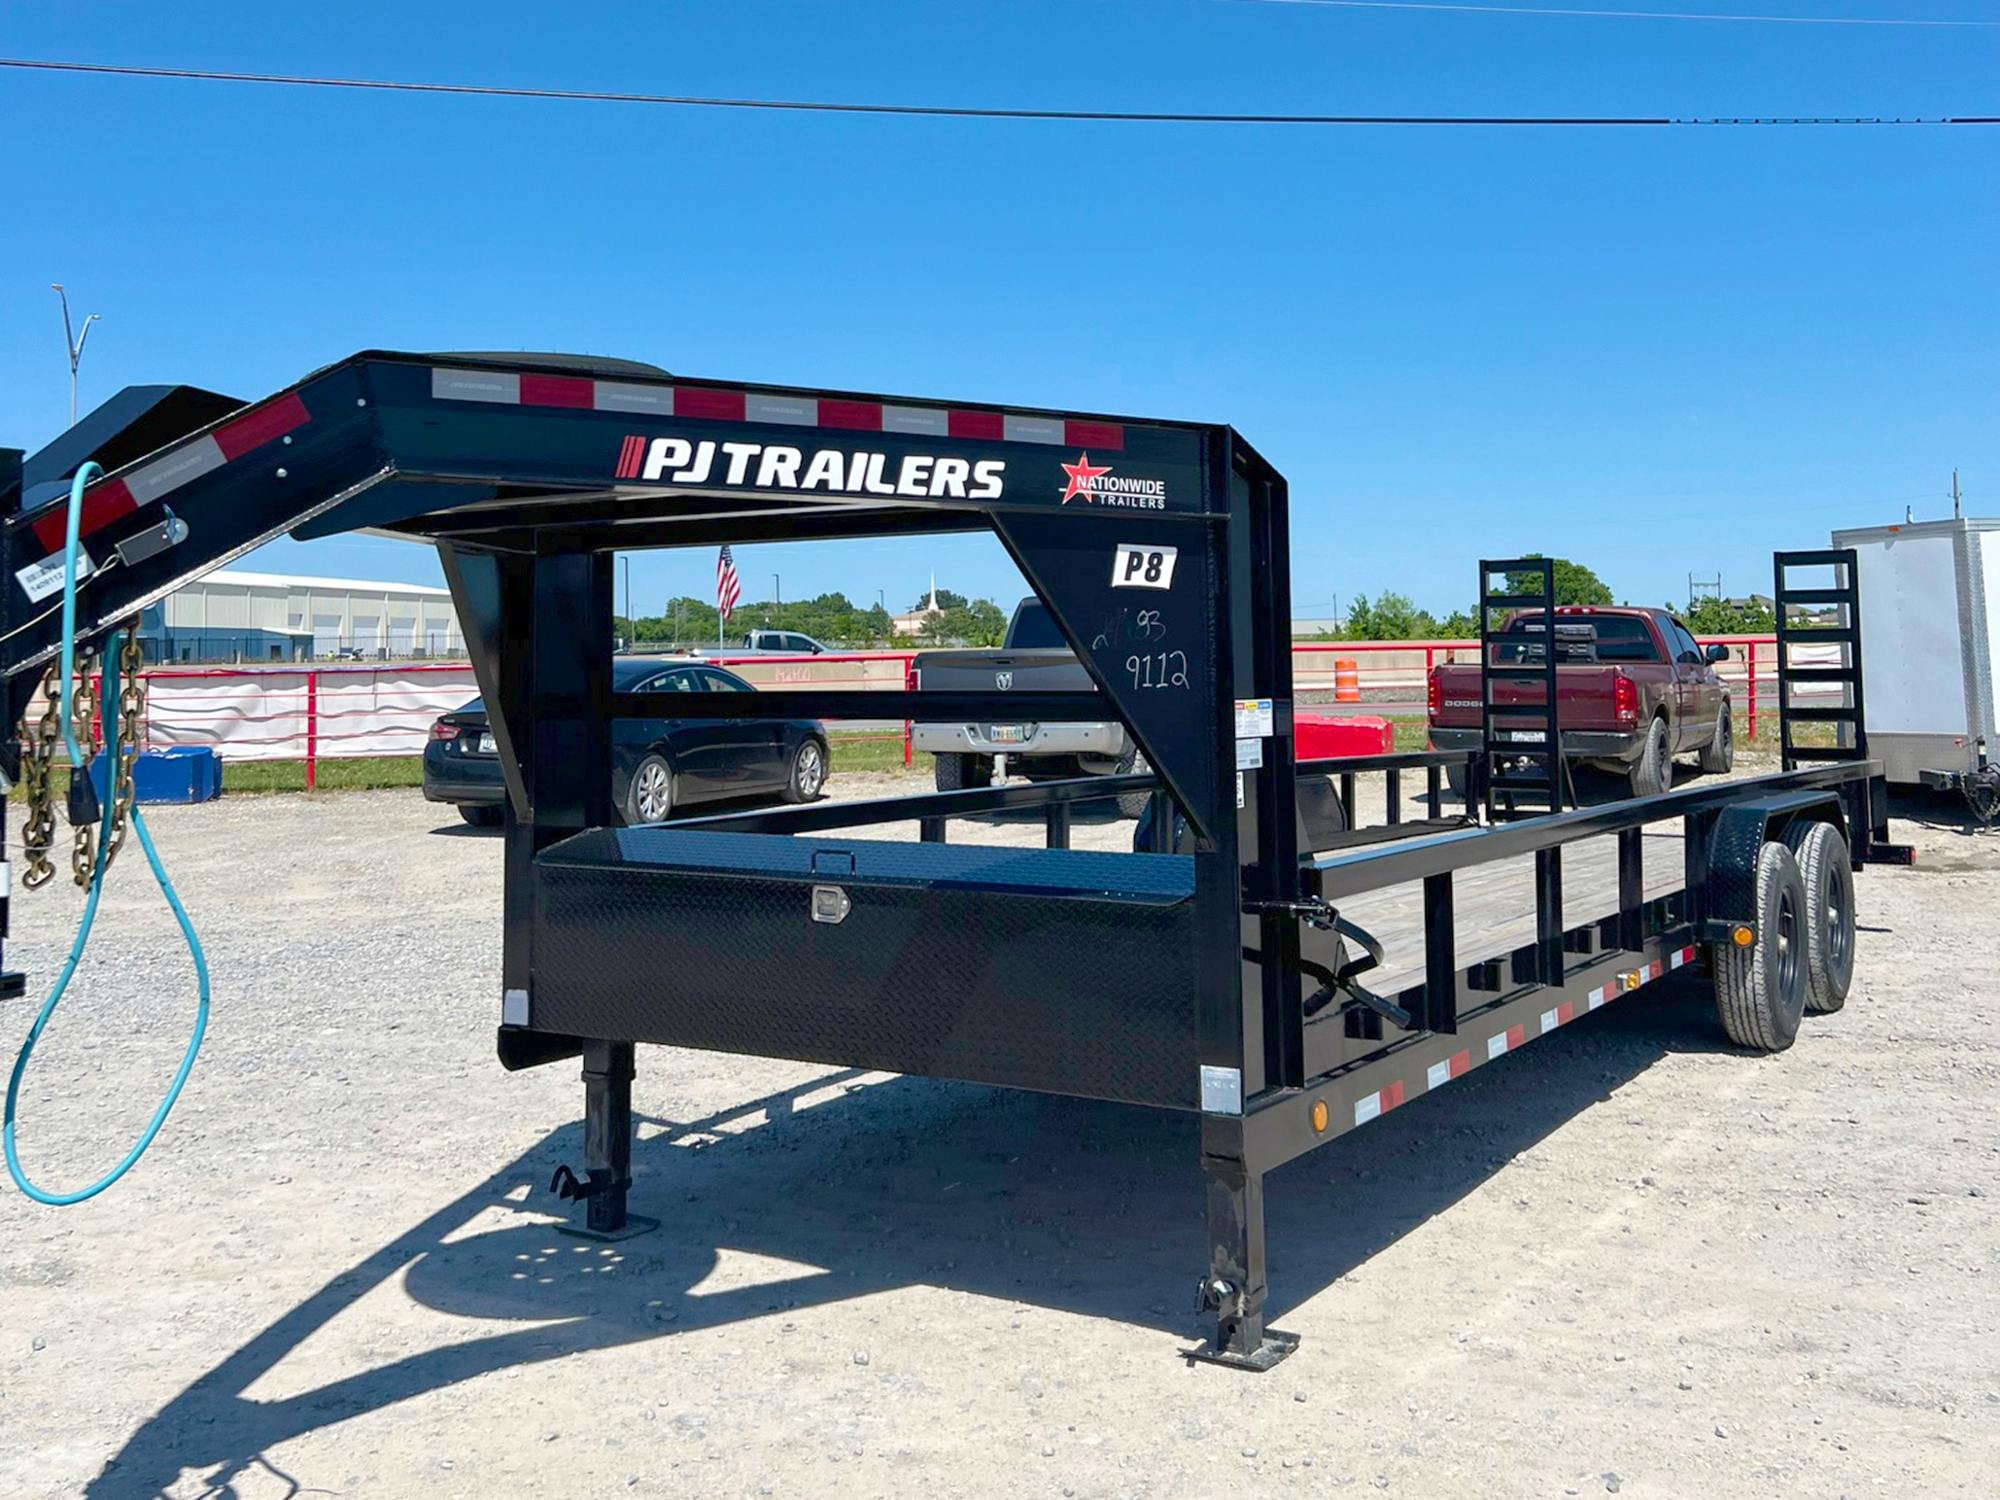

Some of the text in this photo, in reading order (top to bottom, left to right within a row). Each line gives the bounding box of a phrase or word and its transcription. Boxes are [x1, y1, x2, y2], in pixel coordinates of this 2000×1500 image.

[642, 437, 1006, 500] PJ TRAILERS
[1075, 474, 1166, 496] NATIONWIDE
[1099, 494, 1166, 510] TRAILERS
[1123, 550, 1164, 583] P8
[1125, 650, 1191, 691] 9112
